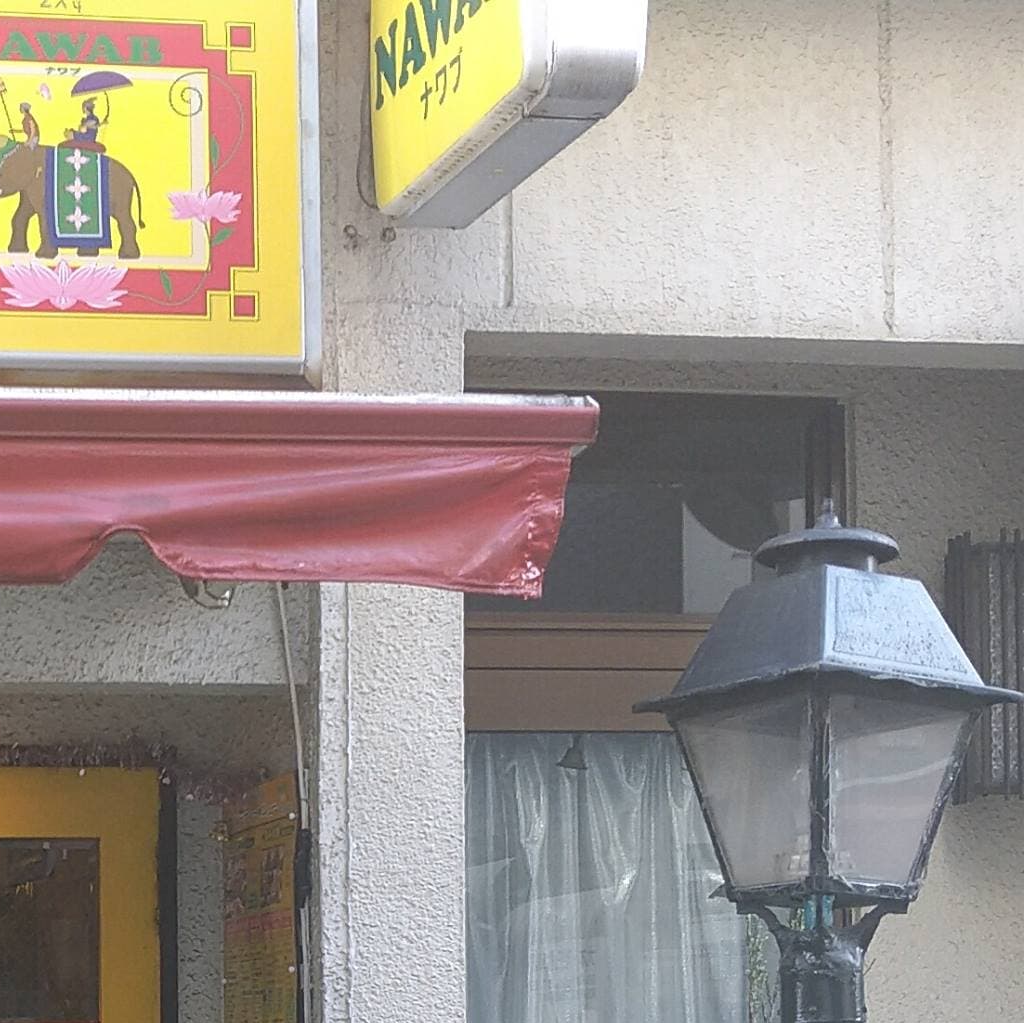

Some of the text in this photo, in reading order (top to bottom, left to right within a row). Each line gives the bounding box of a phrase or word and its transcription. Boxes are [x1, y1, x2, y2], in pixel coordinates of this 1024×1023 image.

[375, 0, 490, 110] NAW
[420, 46, 463, 120] ナワブ
